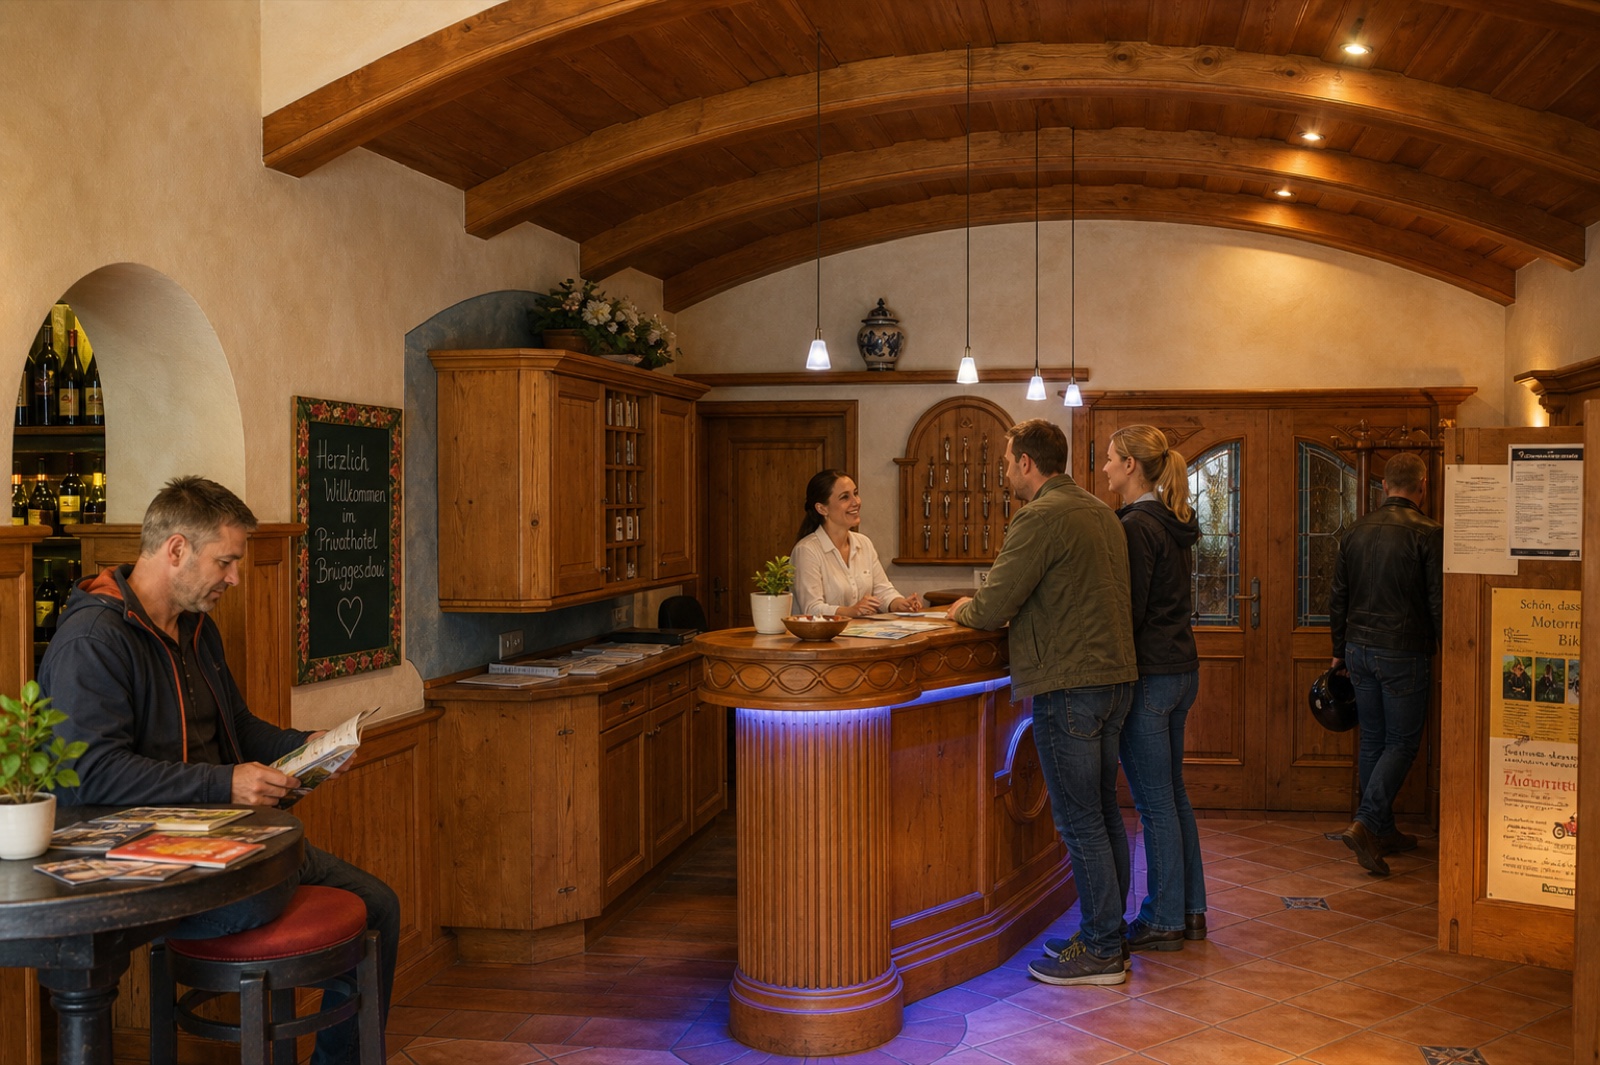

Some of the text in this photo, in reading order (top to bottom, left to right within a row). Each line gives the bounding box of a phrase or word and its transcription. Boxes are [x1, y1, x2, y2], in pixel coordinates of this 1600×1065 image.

[316, 439, 369, 472] Herzlich
[324, 477, 386, 503] Willkommen
[342, 507, 356, 523] im
[314, 527, 378, 551] Privathotel
[1557, 601, 1581, 612] dass
